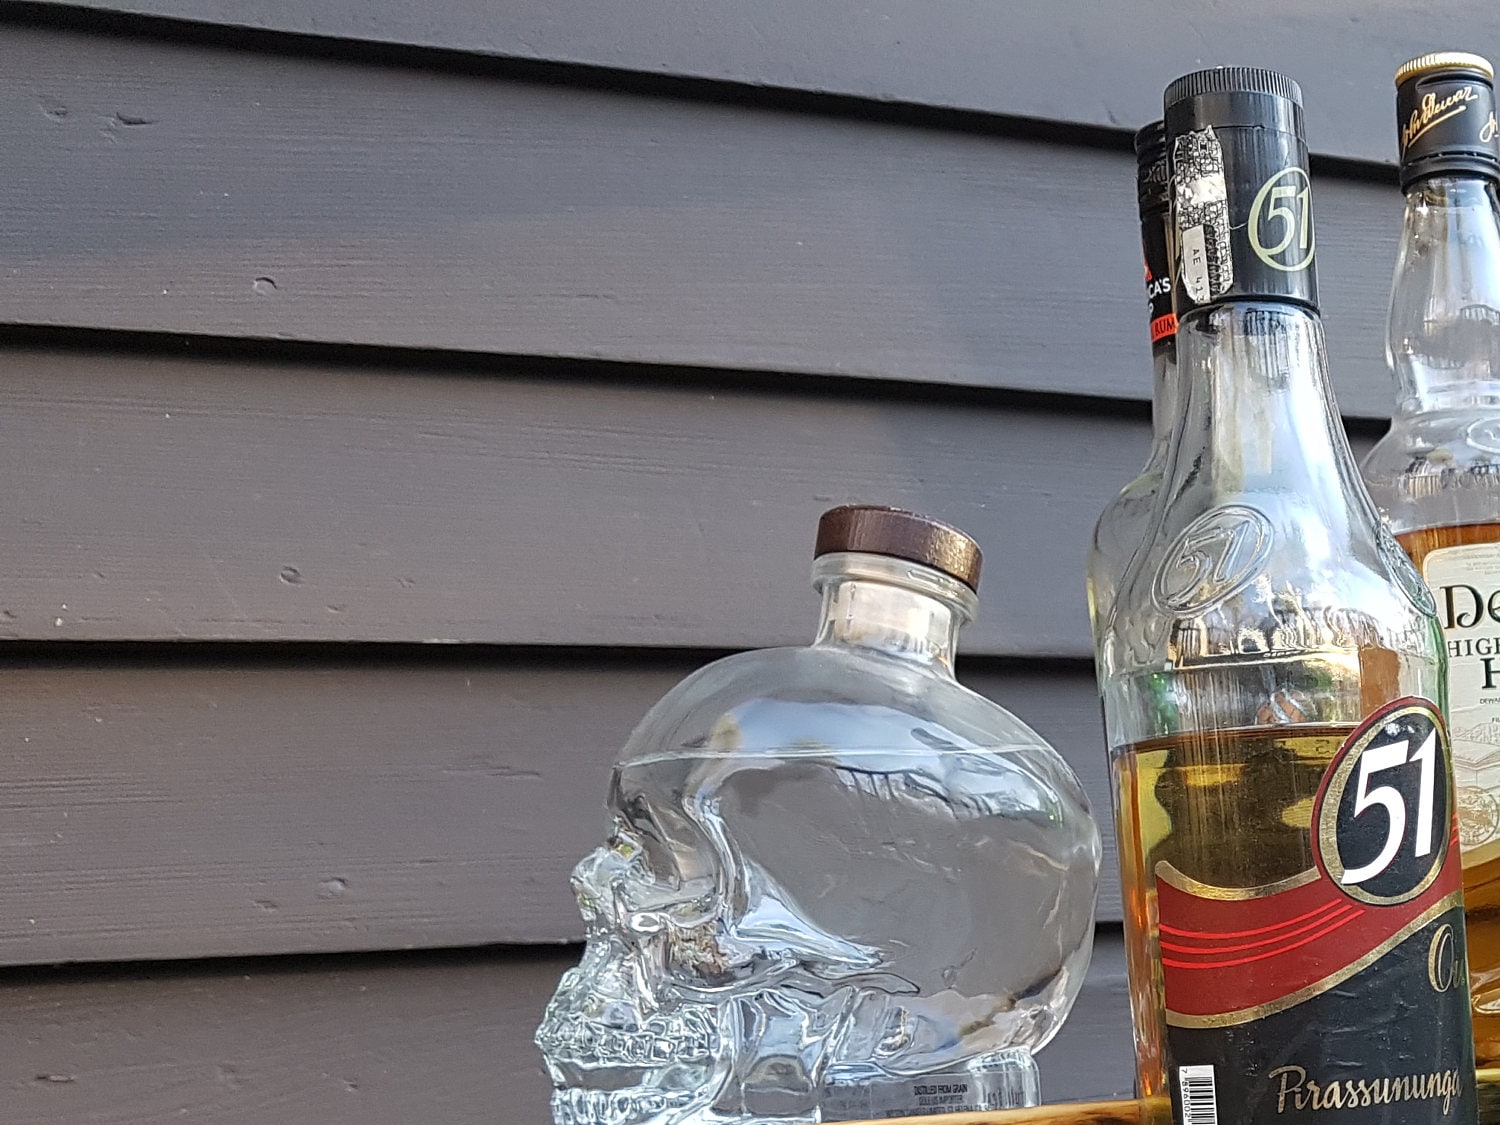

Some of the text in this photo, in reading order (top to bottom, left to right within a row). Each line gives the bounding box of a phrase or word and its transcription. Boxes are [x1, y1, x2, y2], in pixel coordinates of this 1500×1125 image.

[1258, 185, 1309, 256] 51
[1165, 519, 1252, 608] 51
[1340, 727, 1437, 886] 51
